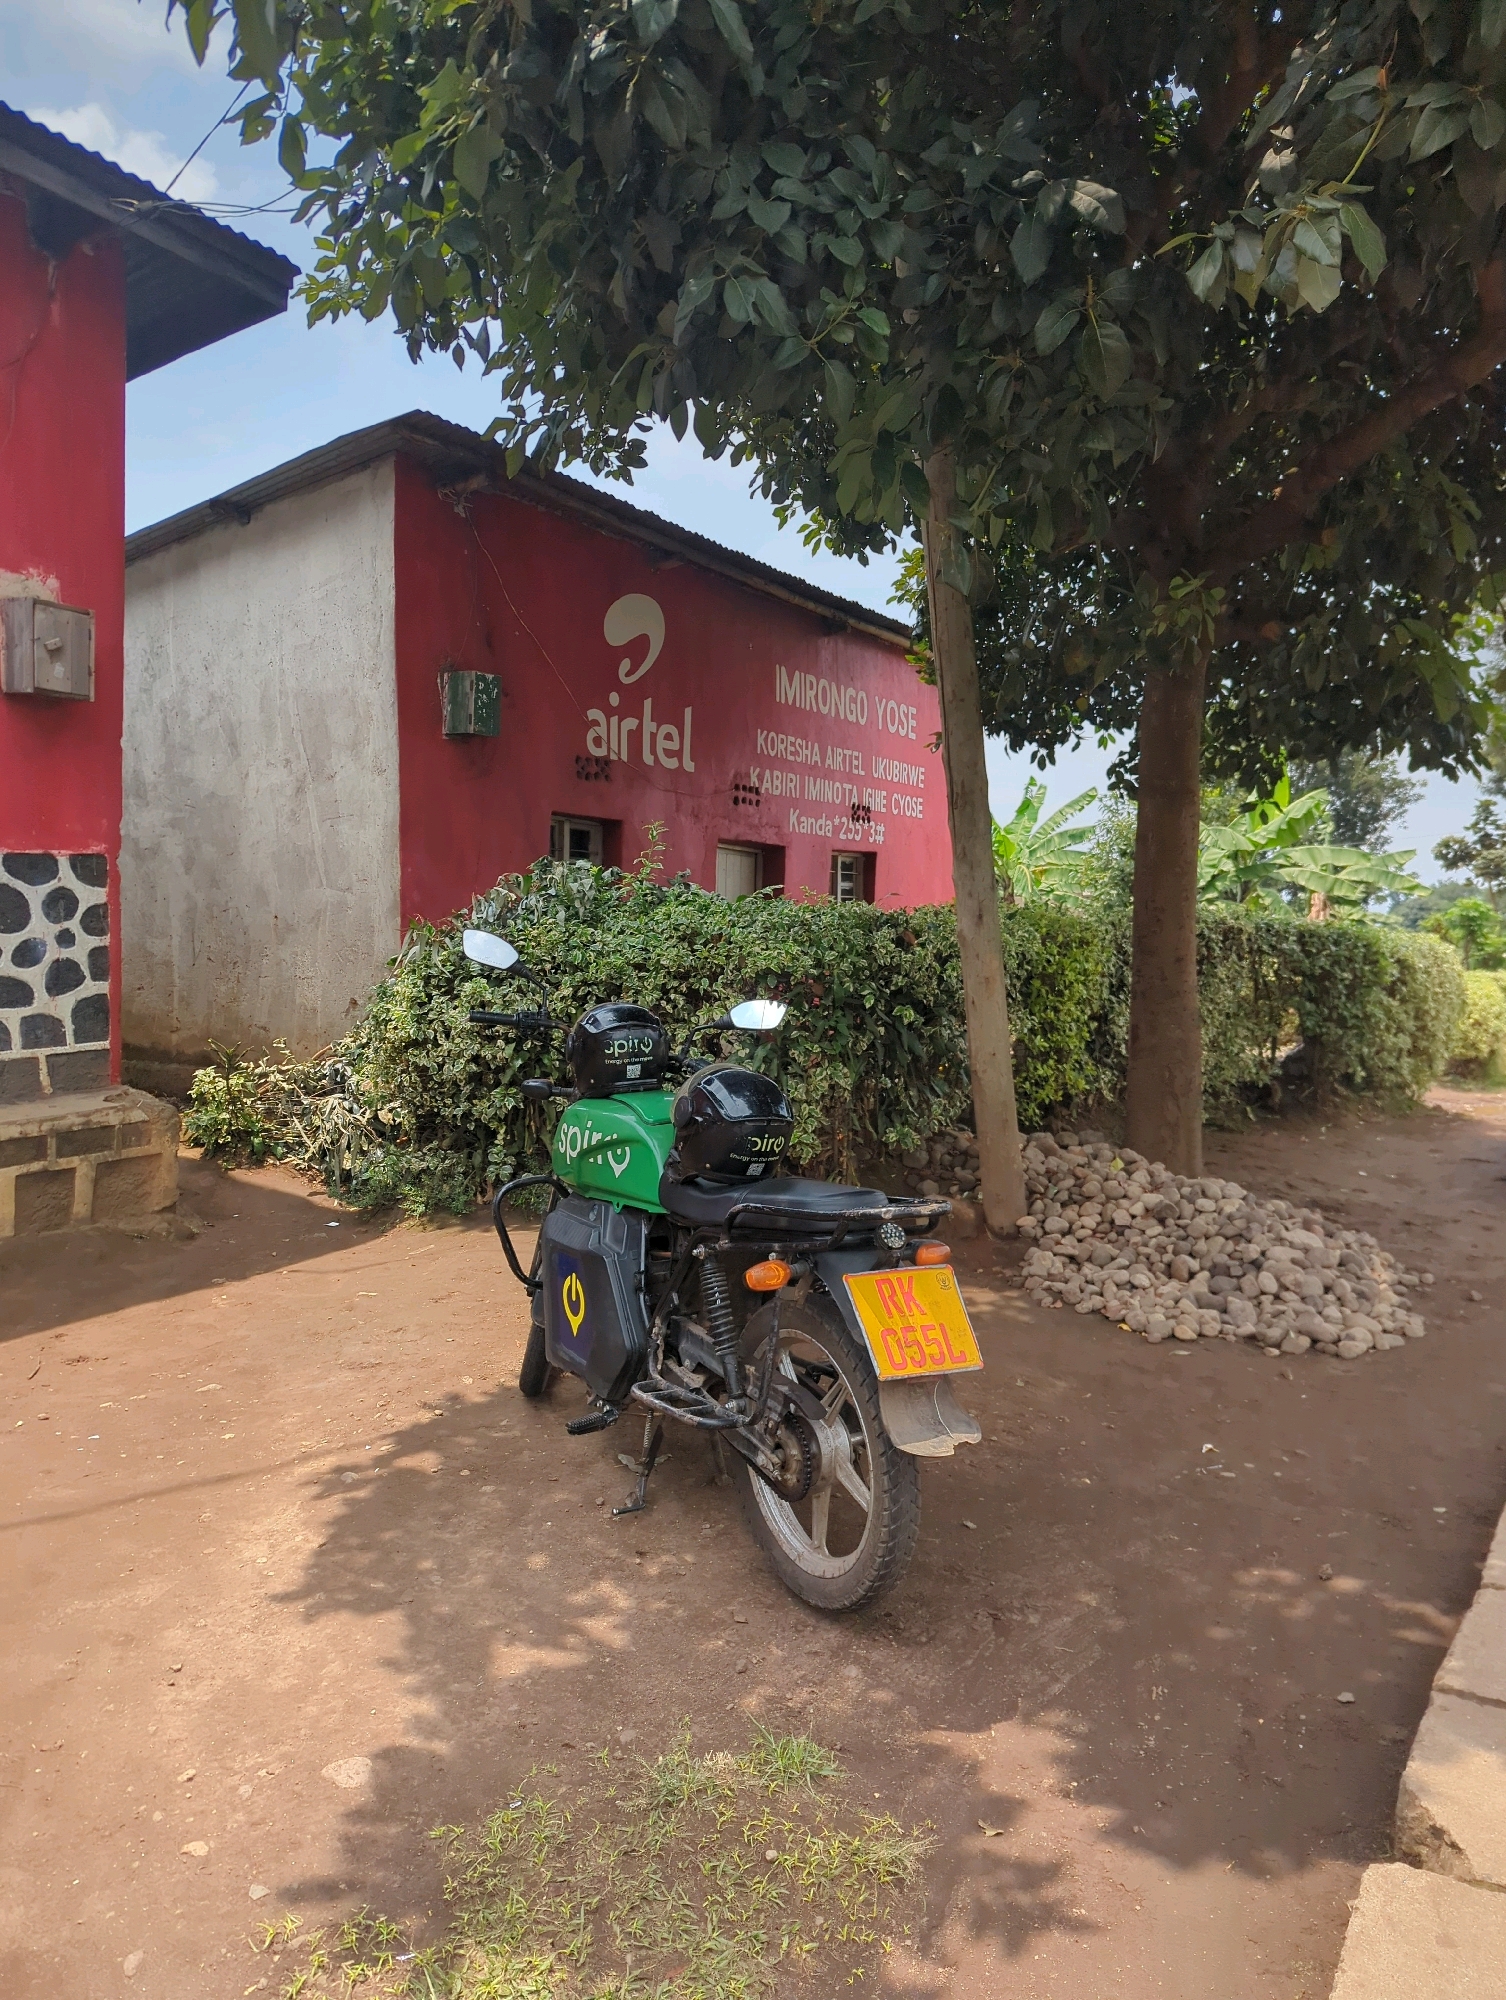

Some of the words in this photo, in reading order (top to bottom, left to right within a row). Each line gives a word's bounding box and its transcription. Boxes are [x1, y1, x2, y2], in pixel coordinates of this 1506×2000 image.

[775, 664, 868, 726] IMIRONGO
[875, 696, 917, 740] YOSE
[586, 692, 695, 772] airtel
[757, 729, 821, 767] KORESHA
[825, 746, 865, 776] AIRTEL
[872, 756, 925, 788] UKUBIRWE
[750, 766, 800, 799] KABIRI
[804, 776, 859, 807] IMINOTA
[863, 787, 887, 813] IGIHE
[891, 793, 924, 819] CYOSE
[875, 1276, 927, 1318] RK
[880, 1323, 967, 1371] 055L
